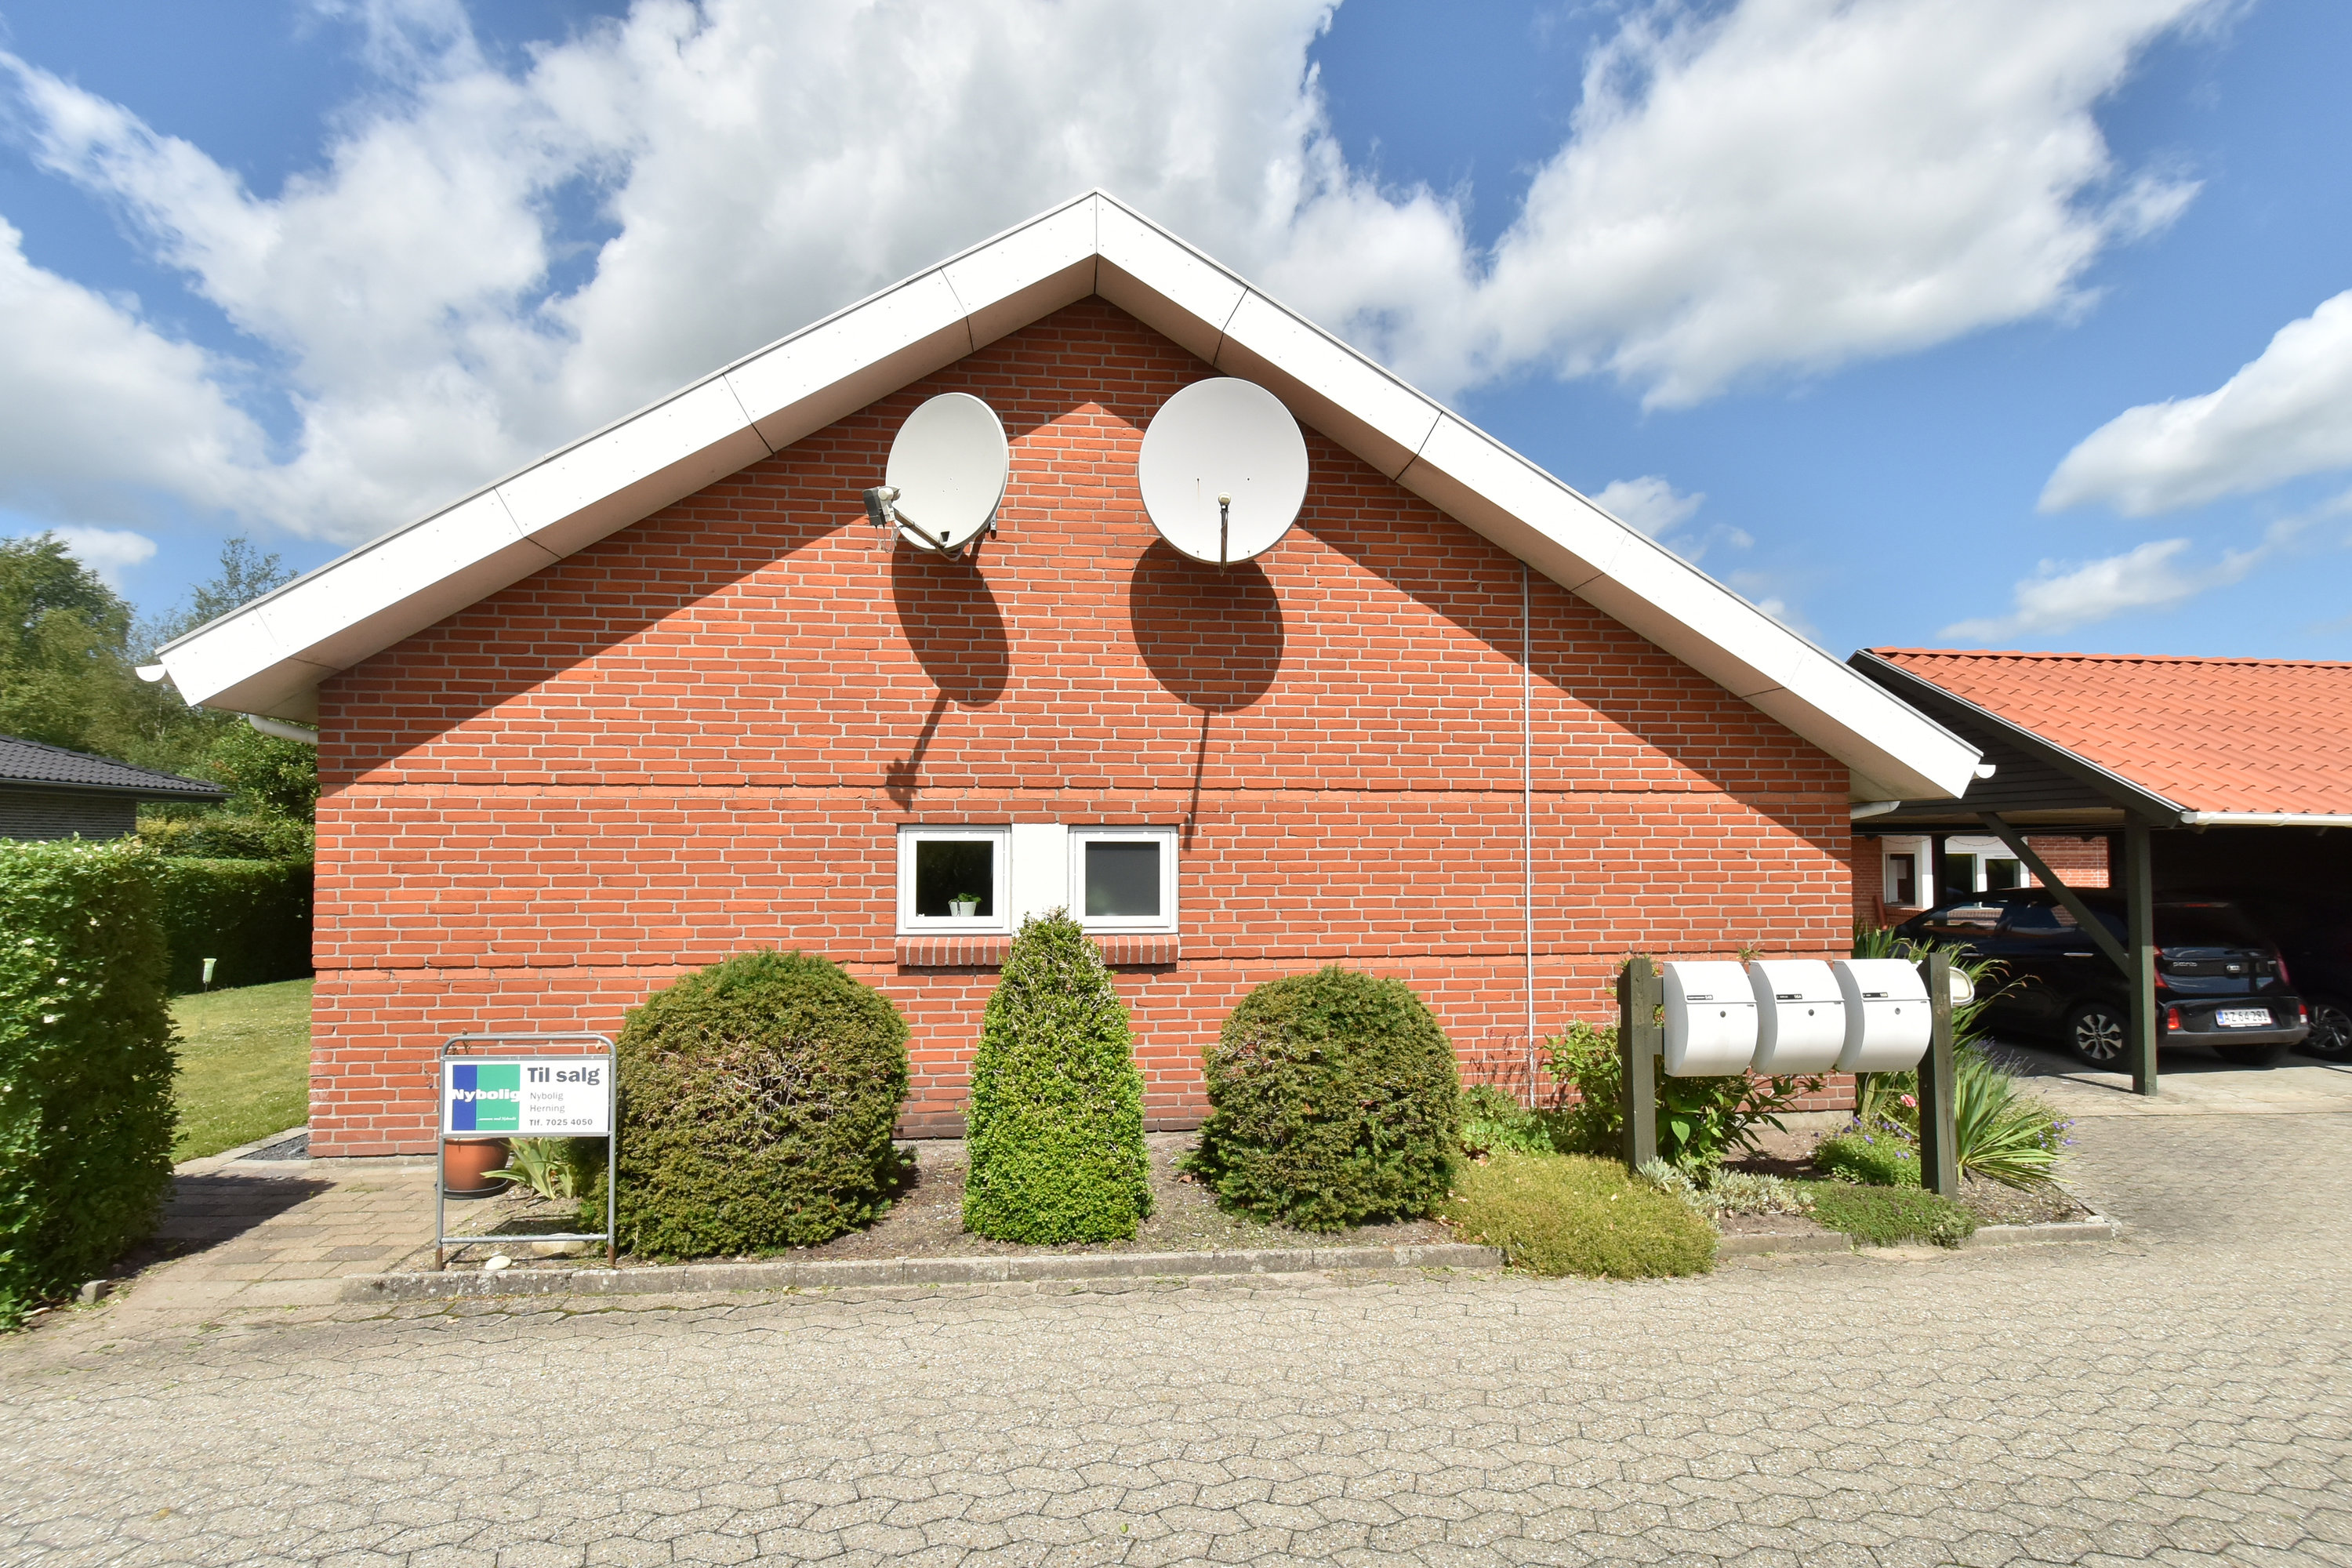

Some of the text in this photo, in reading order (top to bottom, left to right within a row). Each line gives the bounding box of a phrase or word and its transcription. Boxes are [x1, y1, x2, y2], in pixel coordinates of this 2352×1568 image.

[2223, 1011, 2237, 1022] AZ
[2250, 1010, 2267, 1022] 281
[528, 1067, 600, 1085] Til salg
[452, 1088, 521, 1103] Nybolig
[530, 1092, 564, 1101] Nybolig
[530, 1105, 565, 1113] Herning
